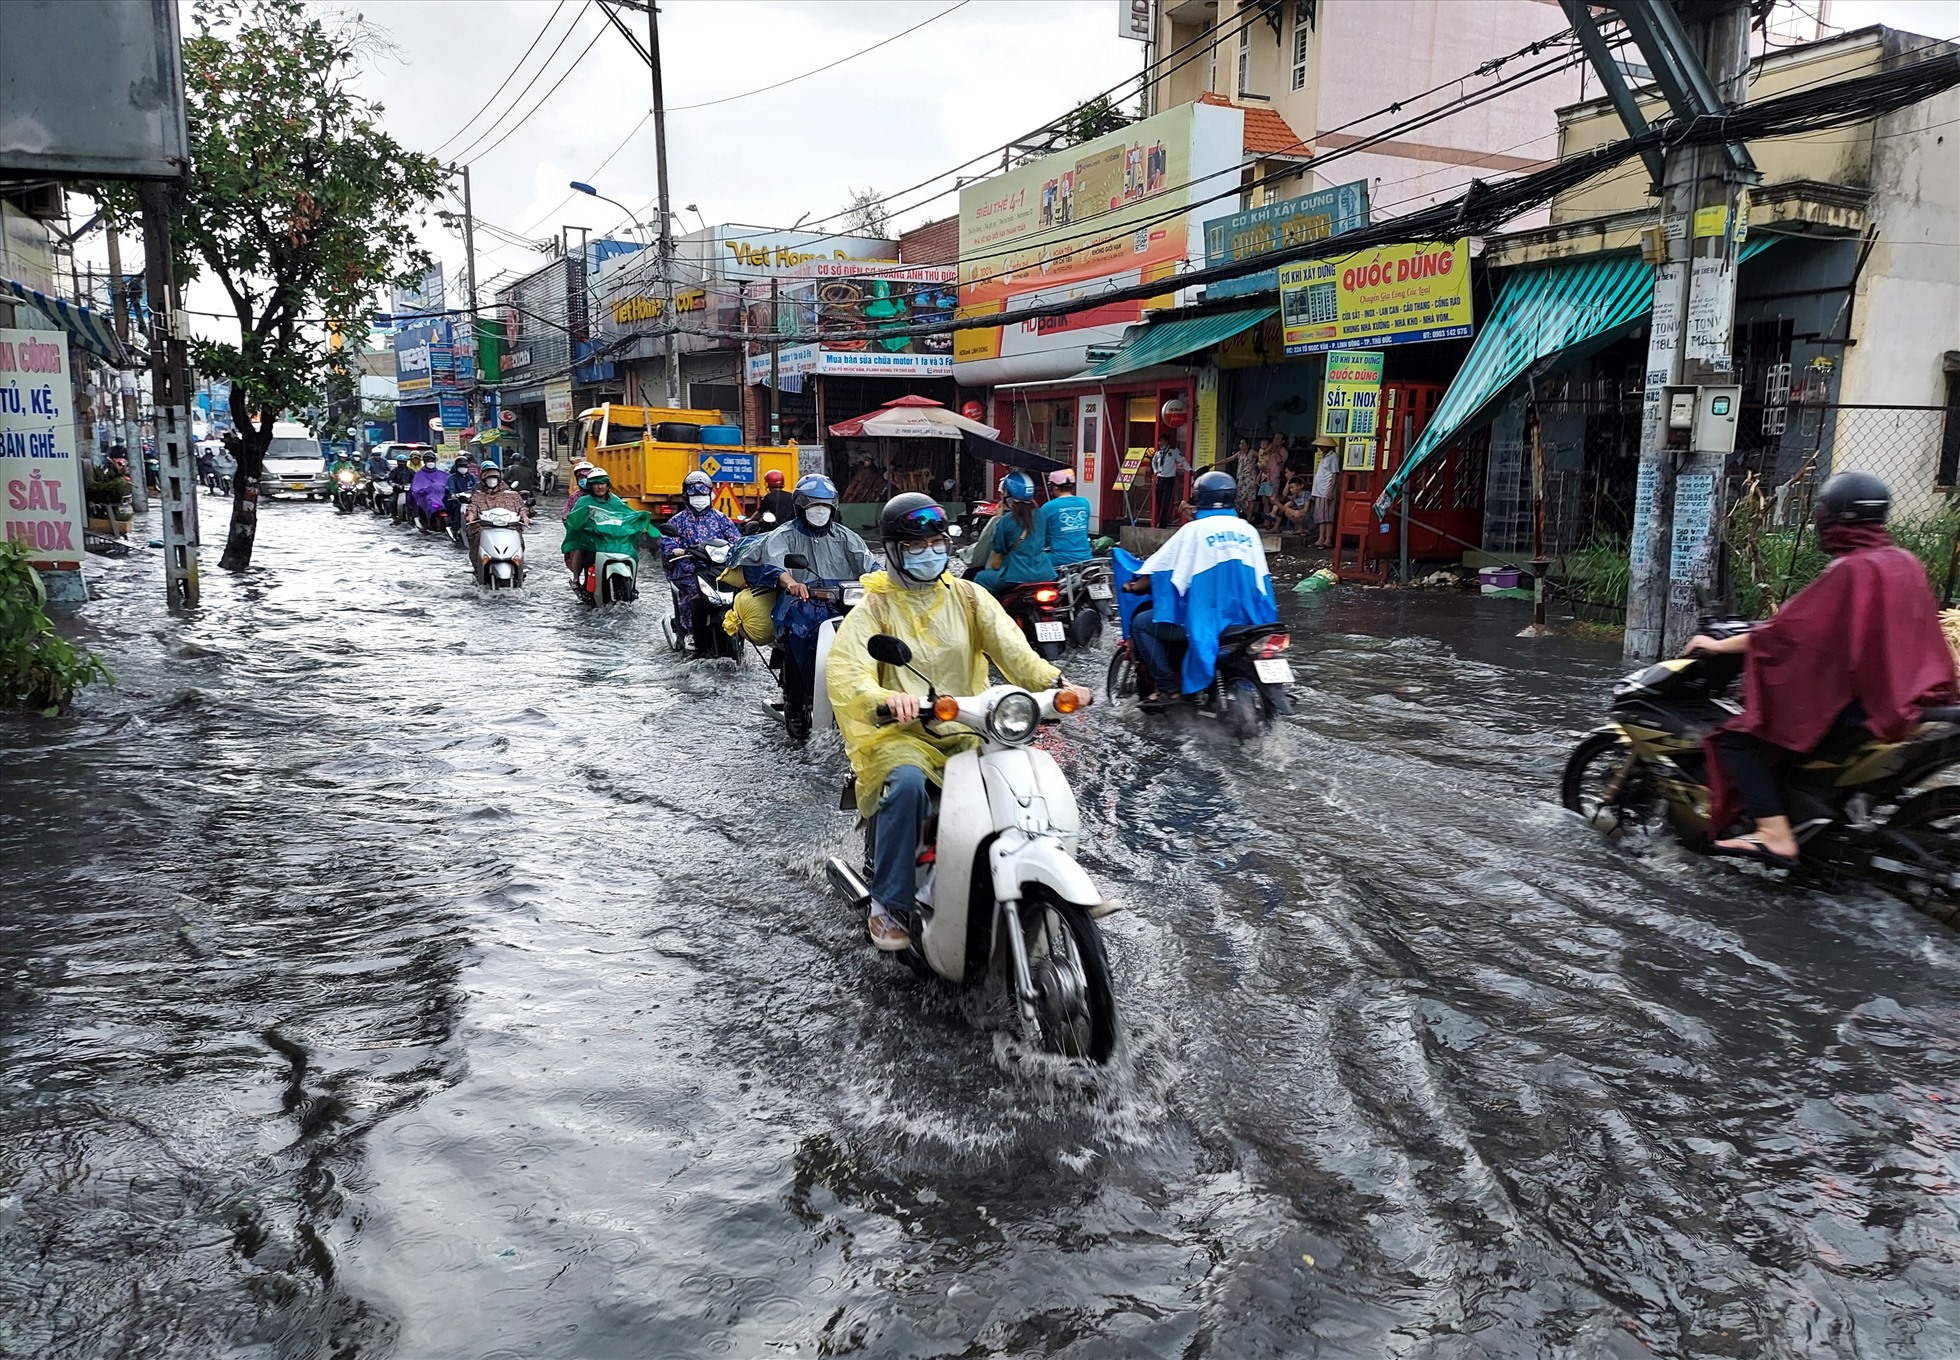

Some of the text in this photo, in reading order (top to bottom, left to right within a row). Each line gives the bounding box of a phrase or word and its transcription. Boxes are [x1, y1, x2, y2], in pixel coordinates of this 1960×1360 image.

[1232, 194, 1334, 228] CƠ KHÍ XÂY DỰNG
[725, 241, 770, 267] Viet
[818, 265, 829, 275] CƠ
[831, 263, 842, 277] SỞ
[1282, 271, 1290, 285] CƠ
[1292, 268, 1302, 283] KHÍ
[1304, 266, 1316, 281] XÂY
[1318, 264, 1336, 281] DỰNG
[1343, 250, 1454, 292] QUỐC DŨNG
[1360, 294, 1380, 304] Chuyên
[1381, 291, 1391, 301] Gia
[1407, 288, 1417, 297] Các
[1365, 309, 1375, 318] INOX
[1379, 307, 1389, 316] LAN
[1389, 307, 1399, 315] CAN
[1414, 301, 1431, 312] THANG
[1343, 325, 1360, 335] KHUNG
[1361, 322, 1372, 332] NHÀ
[1395, 318, 1406, 328] NHÀ
[1407, 317, 1418, 326] KHO
[1423, 315, 1435, 324] NHÀ
[1447, 329, 1456, 337] 142
[18, 336, 61, 374] CÔNG
[827, 355, 842, 364] Mua
[844, 355, 858, 364] bán
[860, 355, 872, 366] sửa
[874, 356, 892, 365] chữa
[893, 357, 913, 366] motor
[916, 358, 919, 366] 1
[930, 358, 938, 366] và
[940, 358, 944, 366] 3
[1331, 355, 1339, 364] CƠ
[1352, 355, 1363, 364] XÂY
[1364, 357, 1381, 366] DỰNG
[1330, 366, 1354, 381] QUỐC
[0, 379, 58, 420] TỦ, KỆ,
[1328, 385, 1378, 408] SẮT INOX
[0, 425, 69, 459] BÀN GHẾ...
[8, 468, 67, 515] SẮT,
[6, 520, 74, 551] INOX
